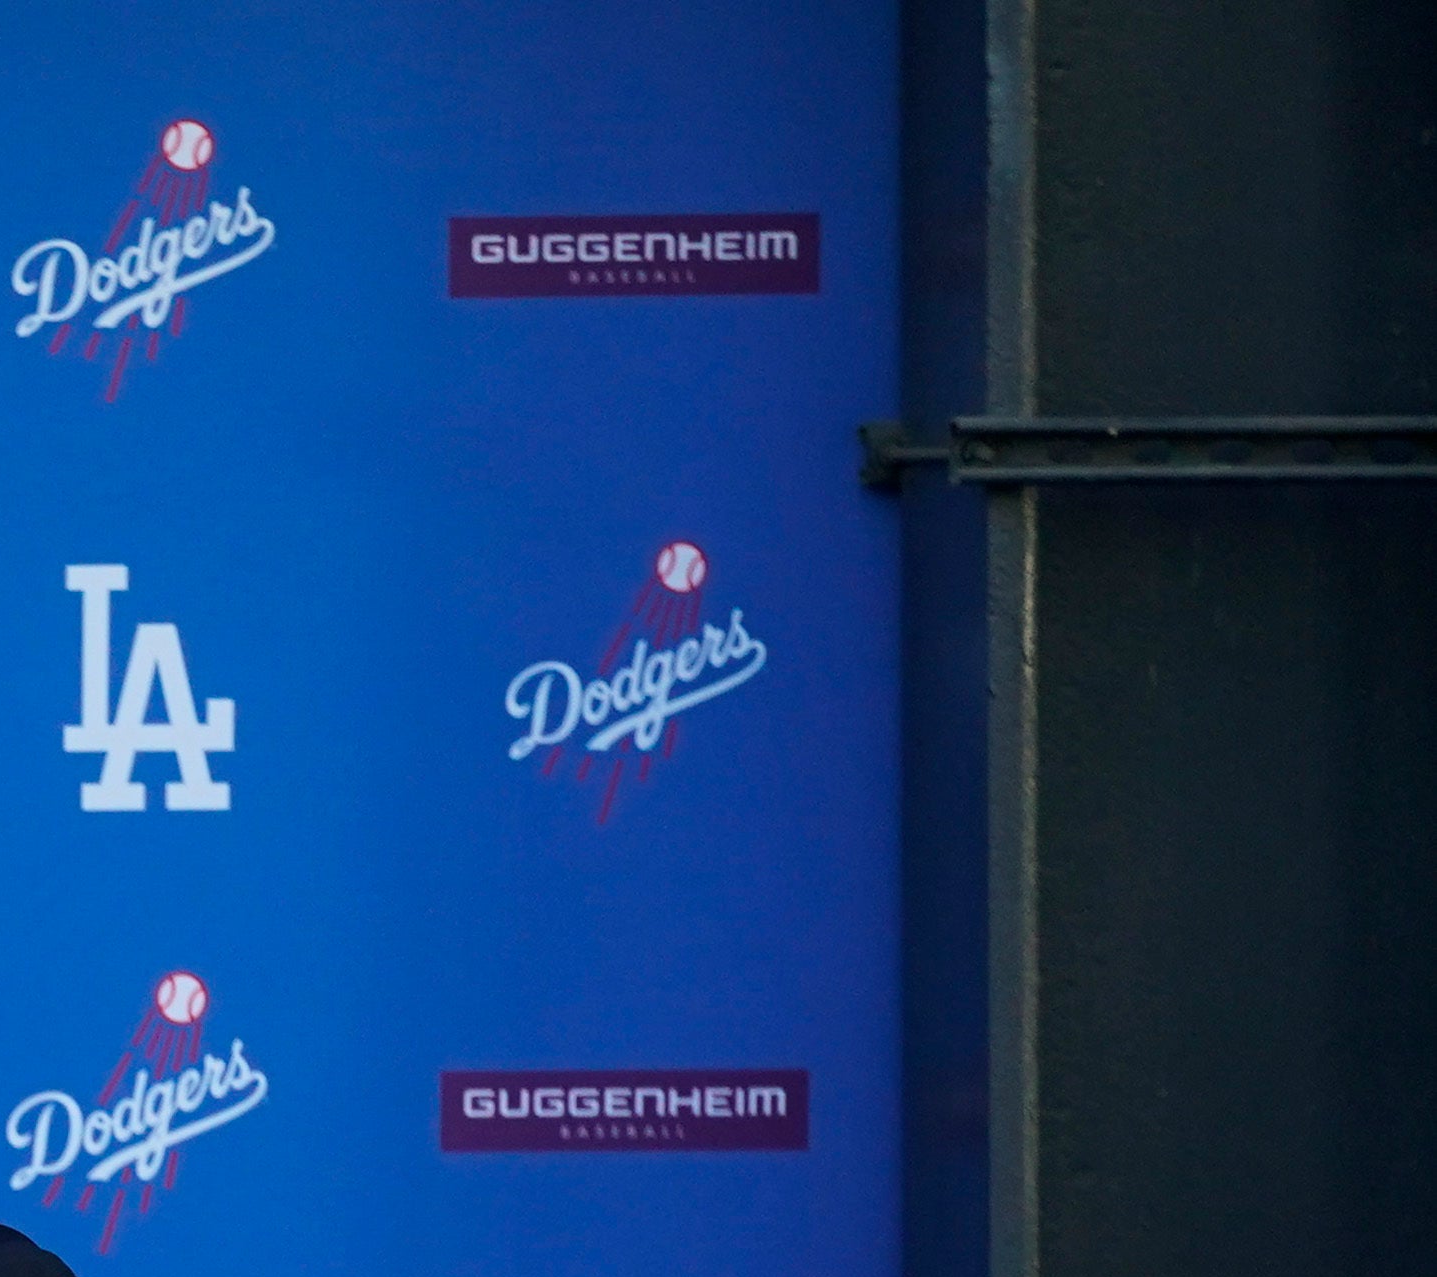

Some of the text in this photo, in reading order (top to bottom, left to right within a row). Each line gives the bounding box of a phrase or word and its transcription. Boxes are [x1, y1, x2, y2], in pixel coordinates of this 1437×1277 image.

[11, 187, 275, 338] Dodgers
[471, 231, 797, 264] GUGGENHEIM
[62, 563, 236, 812] LA
[505, 610, 767, 760] Dodgers
[5, 1039, 268, 1191] Dodgers
[462, 1087, 787, 1119] GUGGENHEIM
